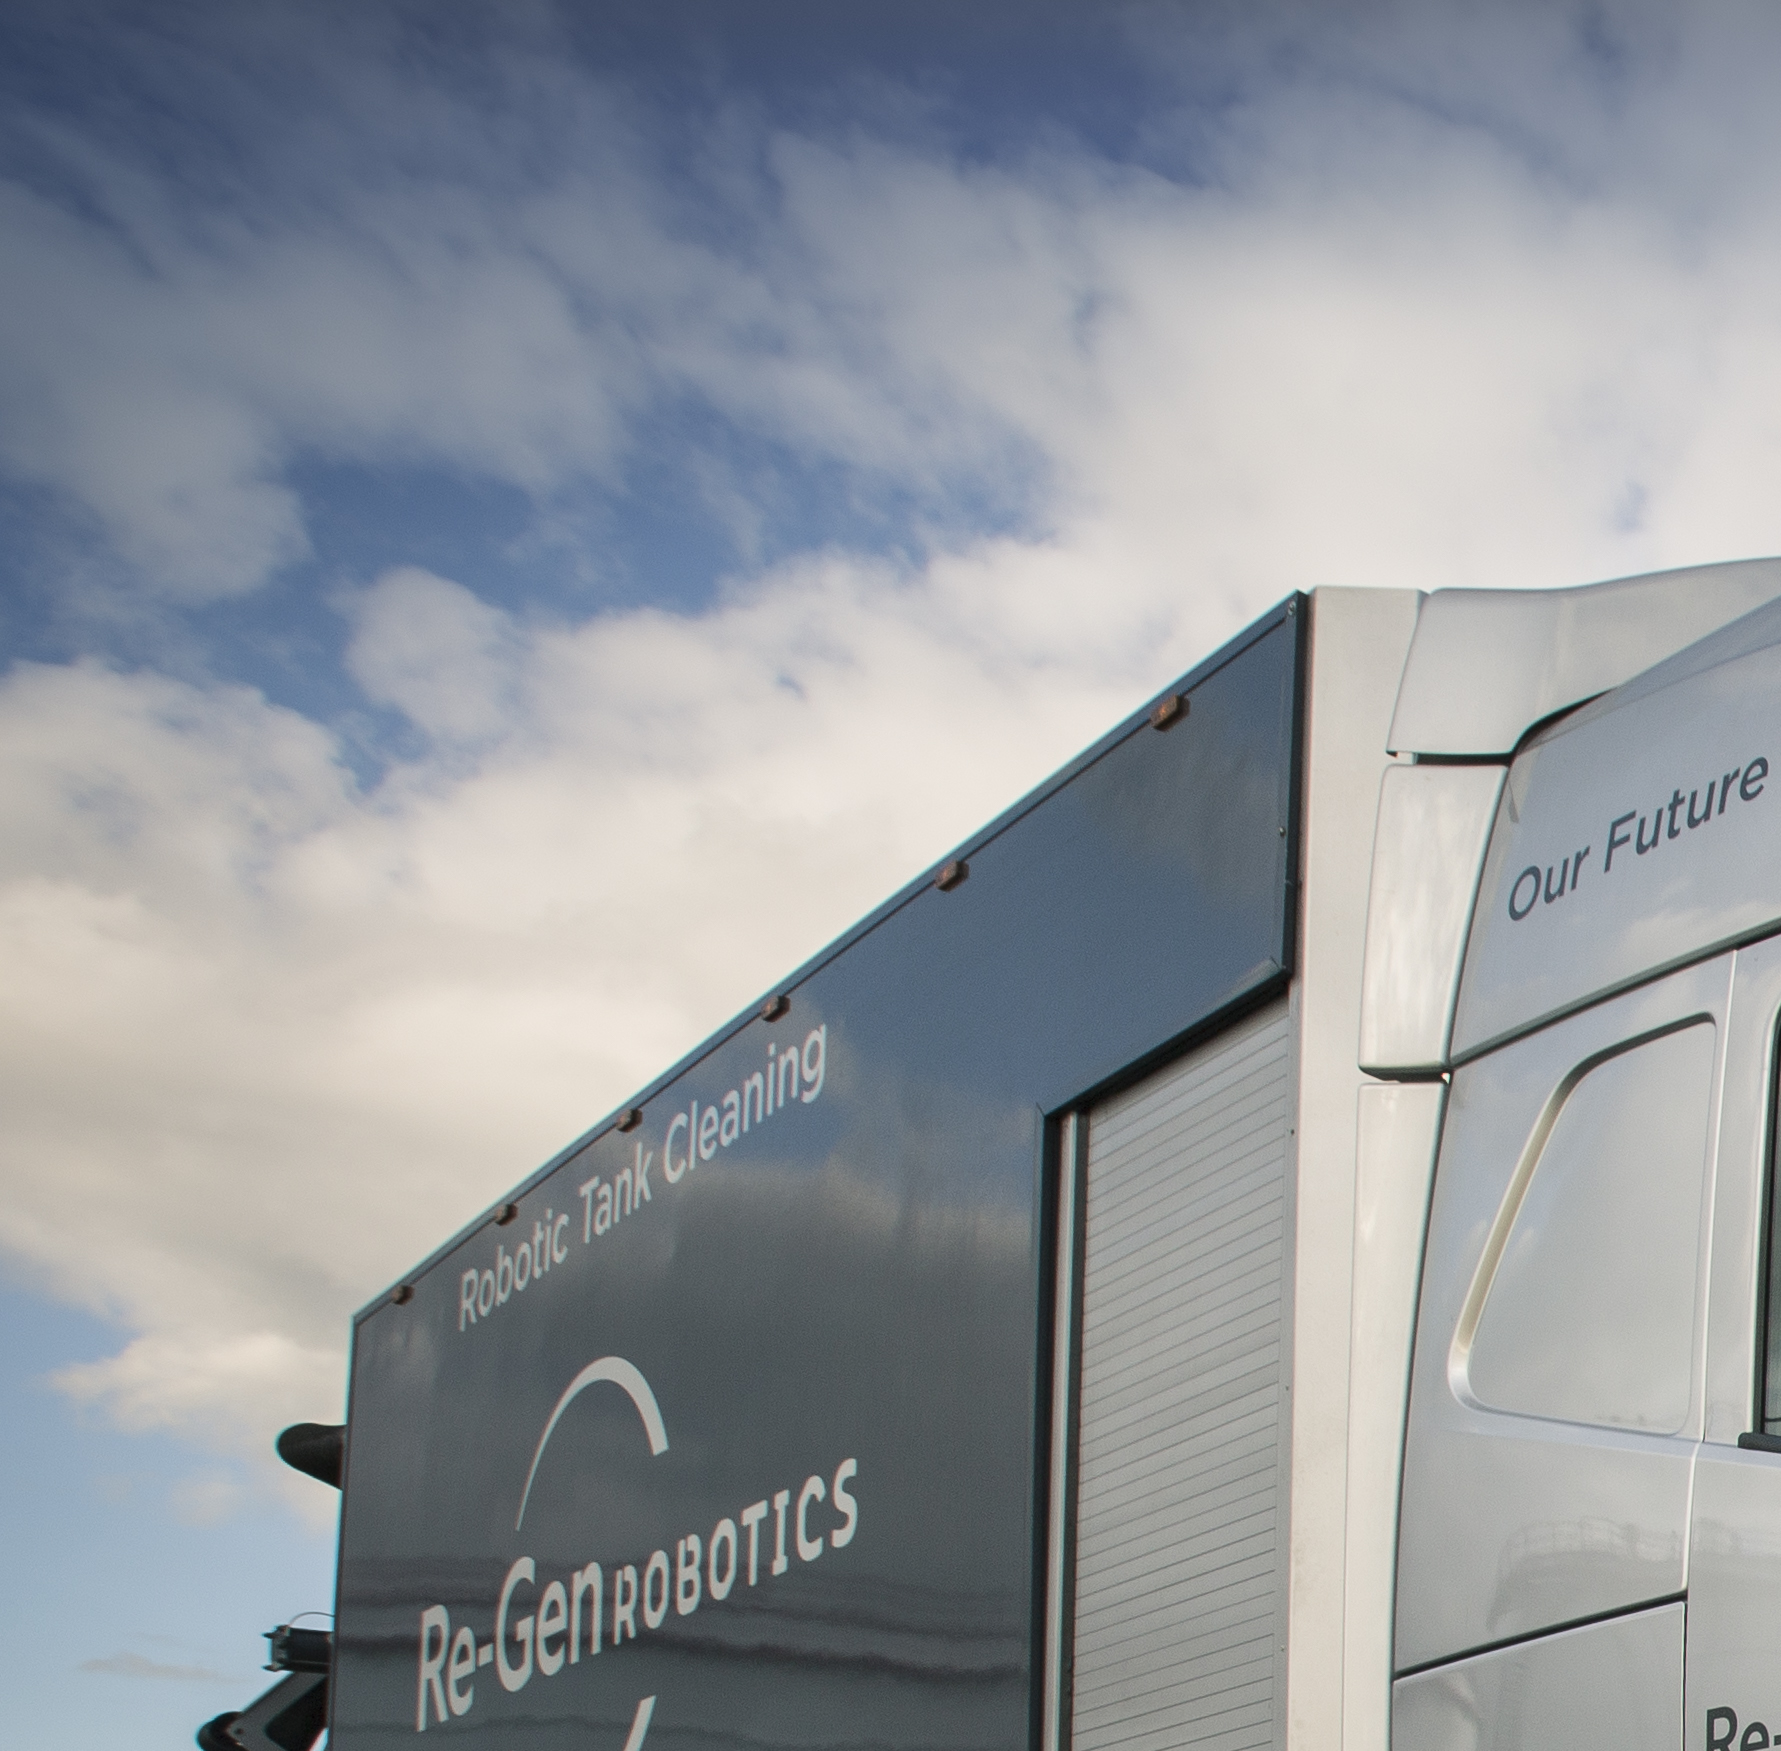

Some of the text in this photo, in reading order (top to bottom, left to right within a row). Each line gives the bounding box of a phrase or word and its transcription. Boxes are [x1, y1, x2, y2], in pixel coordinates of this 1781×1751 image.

[1508, 845, 1591, 922] Our
[1603, 756, 1769, 874] Future
[458, 1023, 828, 1332] Robotic Tank Cleaning
[416, 1457, 859, 1732] Re-Gen ROBOTICS
